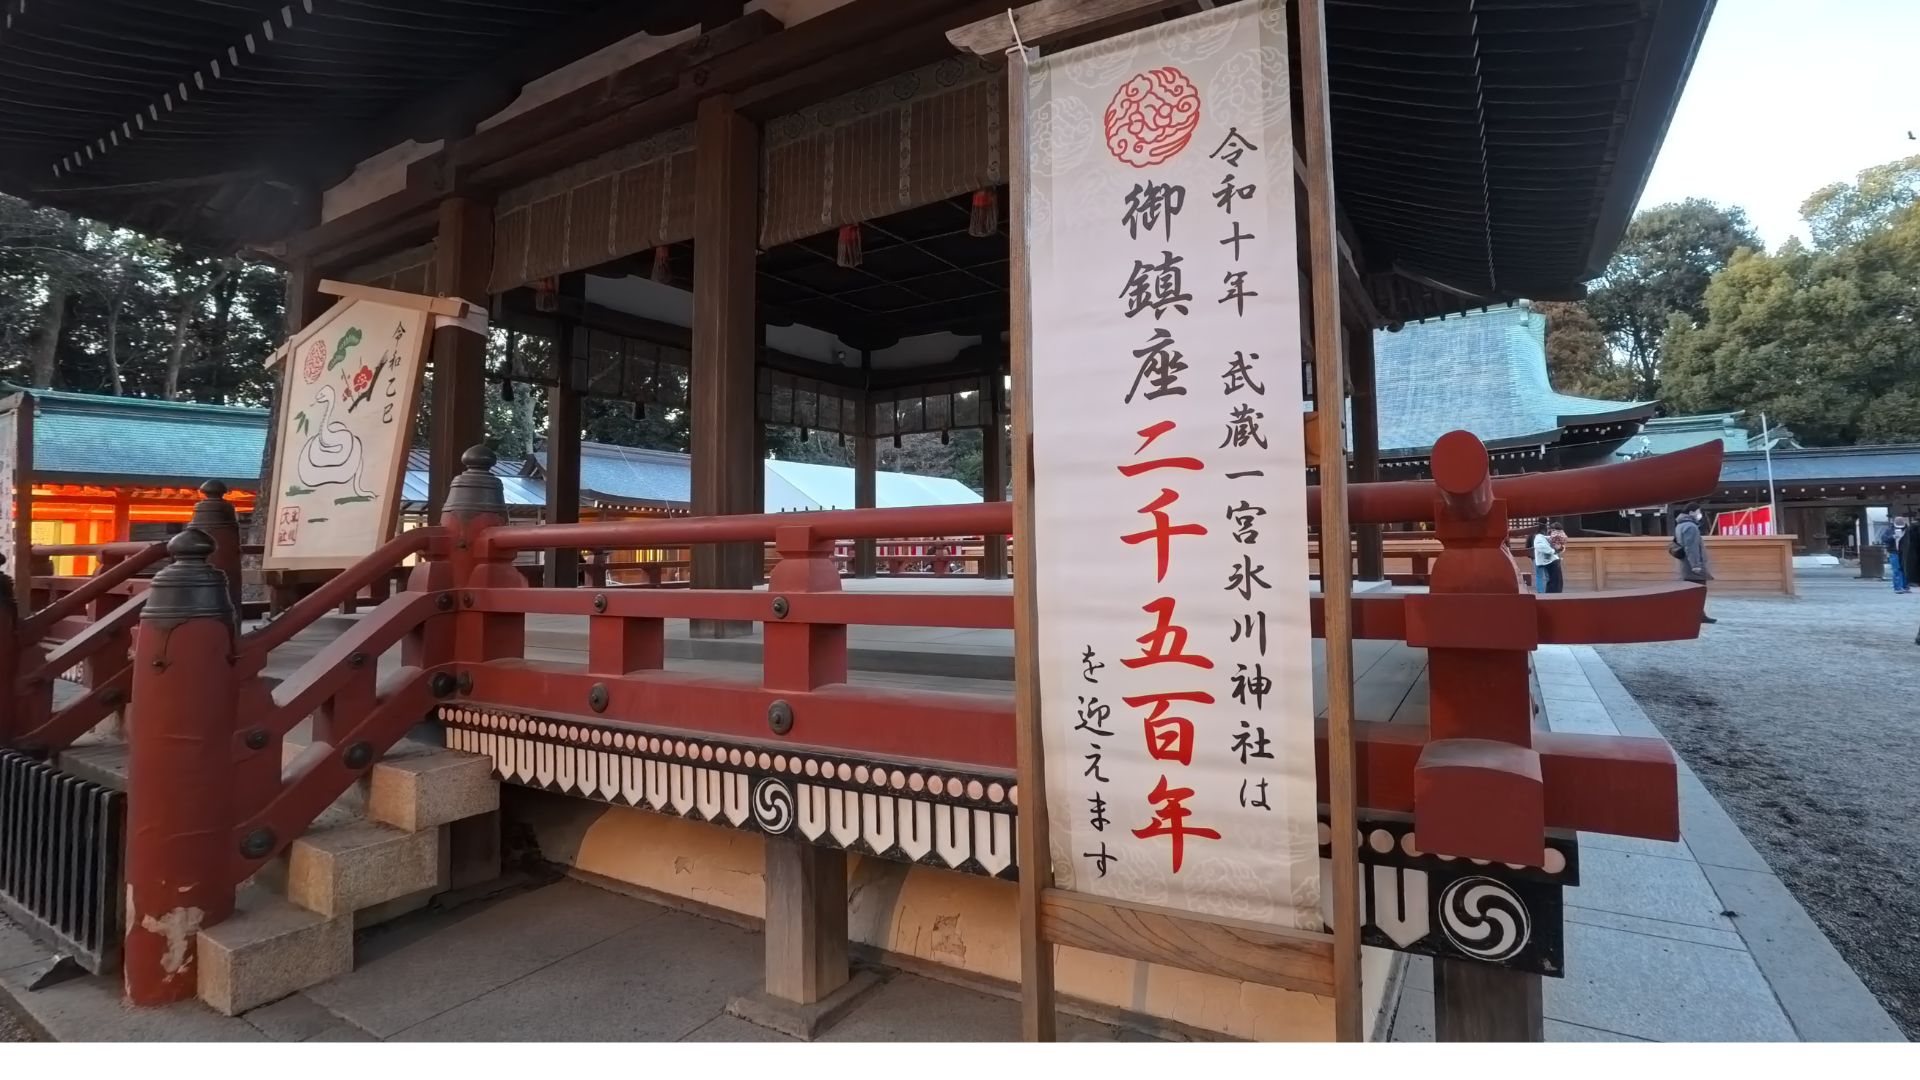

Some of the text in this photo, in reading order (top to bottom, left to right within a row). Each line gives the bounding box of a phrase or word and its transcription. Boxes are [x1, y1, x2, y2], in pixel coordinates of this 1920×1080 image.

[1073, 644, 1118, 879] を迎えます
[1117, 178, 1222, 874] 御鎮座二千五百年
[1208, 126, 1276, 812] 令和十年 武蔵一宮氷川神社は
